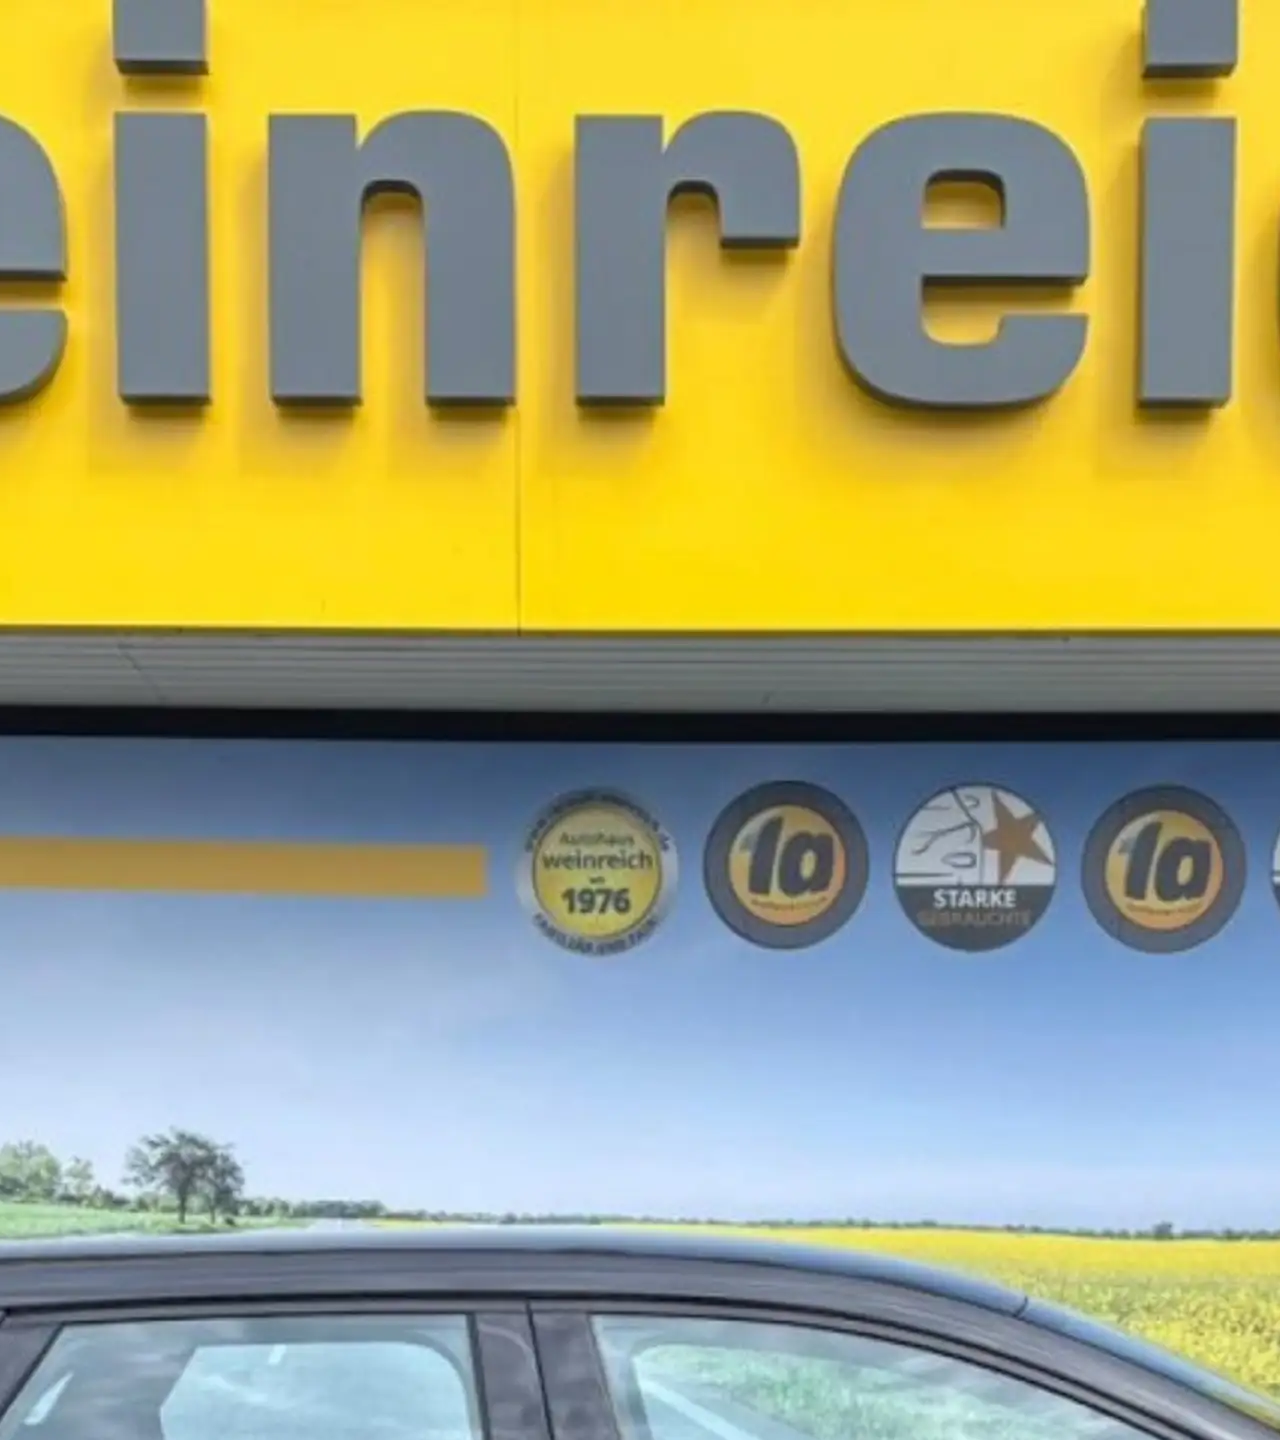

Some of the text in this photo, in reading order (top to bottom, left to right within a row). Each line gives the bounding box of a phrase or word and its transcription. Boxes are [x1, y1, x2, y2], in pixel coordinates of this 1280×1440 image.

[541, 849, 654, 870] weinreich
[560, 887, 632, 915] 1976
[932, 888, 1018, 909] STARKE
